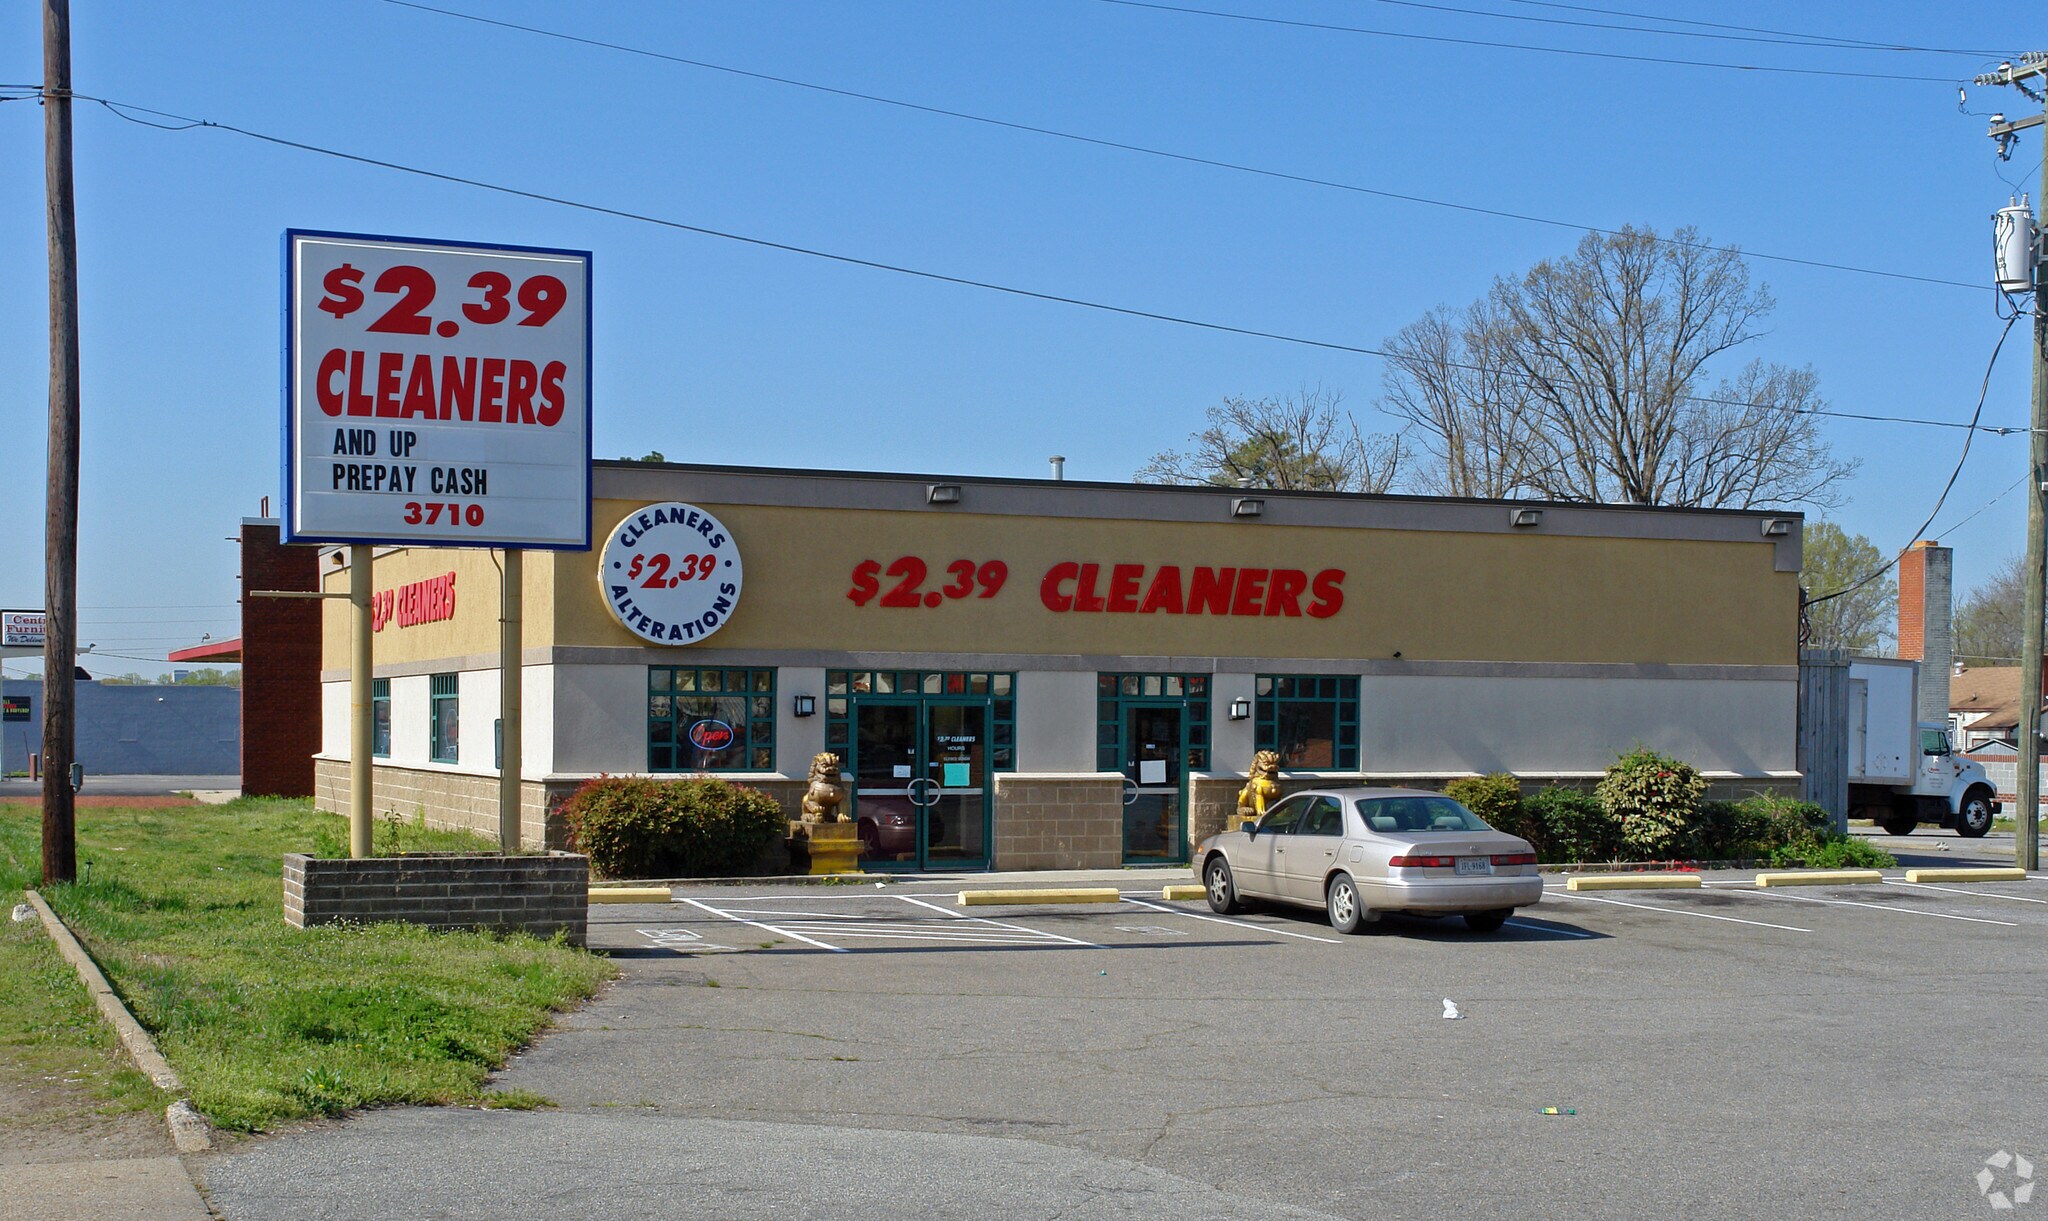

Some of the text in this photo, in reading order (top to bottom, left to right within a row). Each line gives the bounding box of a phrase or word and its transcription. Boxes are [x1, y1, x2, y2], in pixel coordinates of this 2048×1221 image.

[317, 263, 567, 338] $2.39
[316, 348, 567, 427] CLEANERS
[333, 428, 417, 457] AND UP
[333, 463, 487, 495] PREPAY CASH
[404, 502, 484, 527] 3710
[620, 507, 726, 549] CLEANERS
[627, 553, 717, 589] $2.39
[846, 556, 1347, 619] $2.39 CLEANERS
[397, 571, 456, 629] CLEANERS
[611, 582, 736, 640] ALTERATIONS
[693, 723, 729, 746] Open
